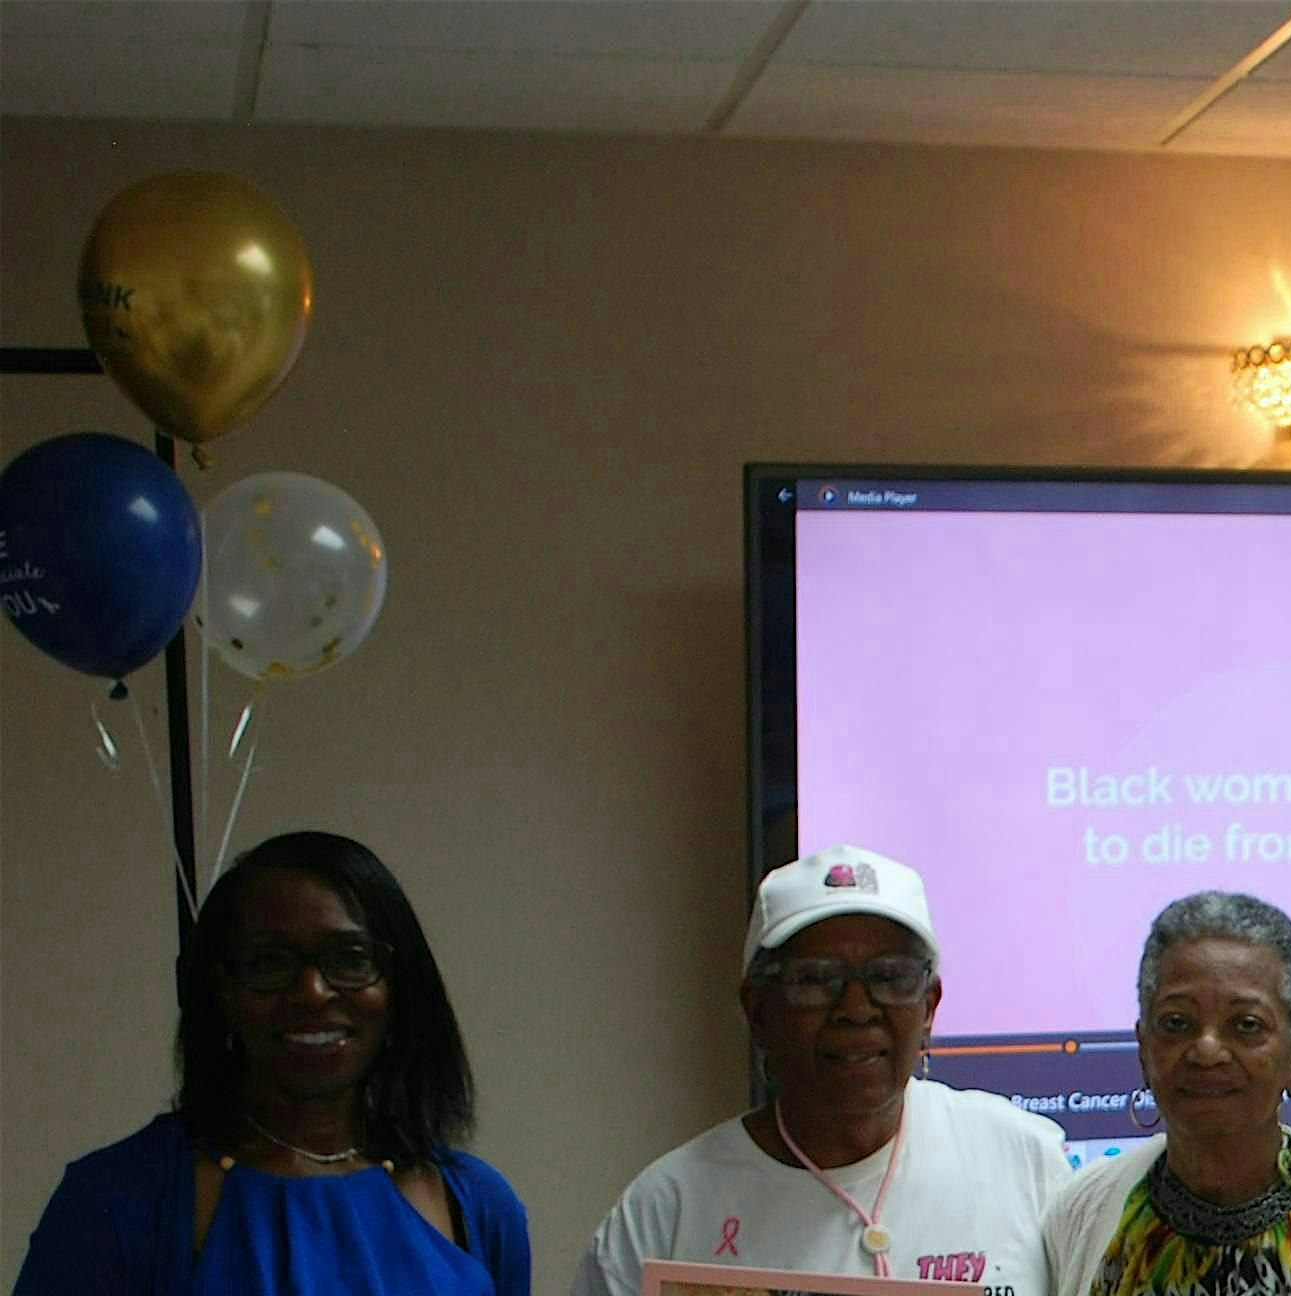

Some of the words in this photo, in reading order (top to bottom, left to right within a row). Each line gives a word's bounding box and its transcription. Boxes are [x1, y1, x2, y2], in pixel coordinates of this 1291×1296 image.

[847, 489, 883, 504] Media
[884, 489, 918, 506] Player
[1047, 765, 1175, 806] Black
[1084, 825, 1130, 865] to
[1140, 823, 1212, 864] die
[1011, 1093, 1066, 1112] Breast
[1068, 1091, 1129, 1112] Cancer
[916, 1250, 986, 1284] THEY
